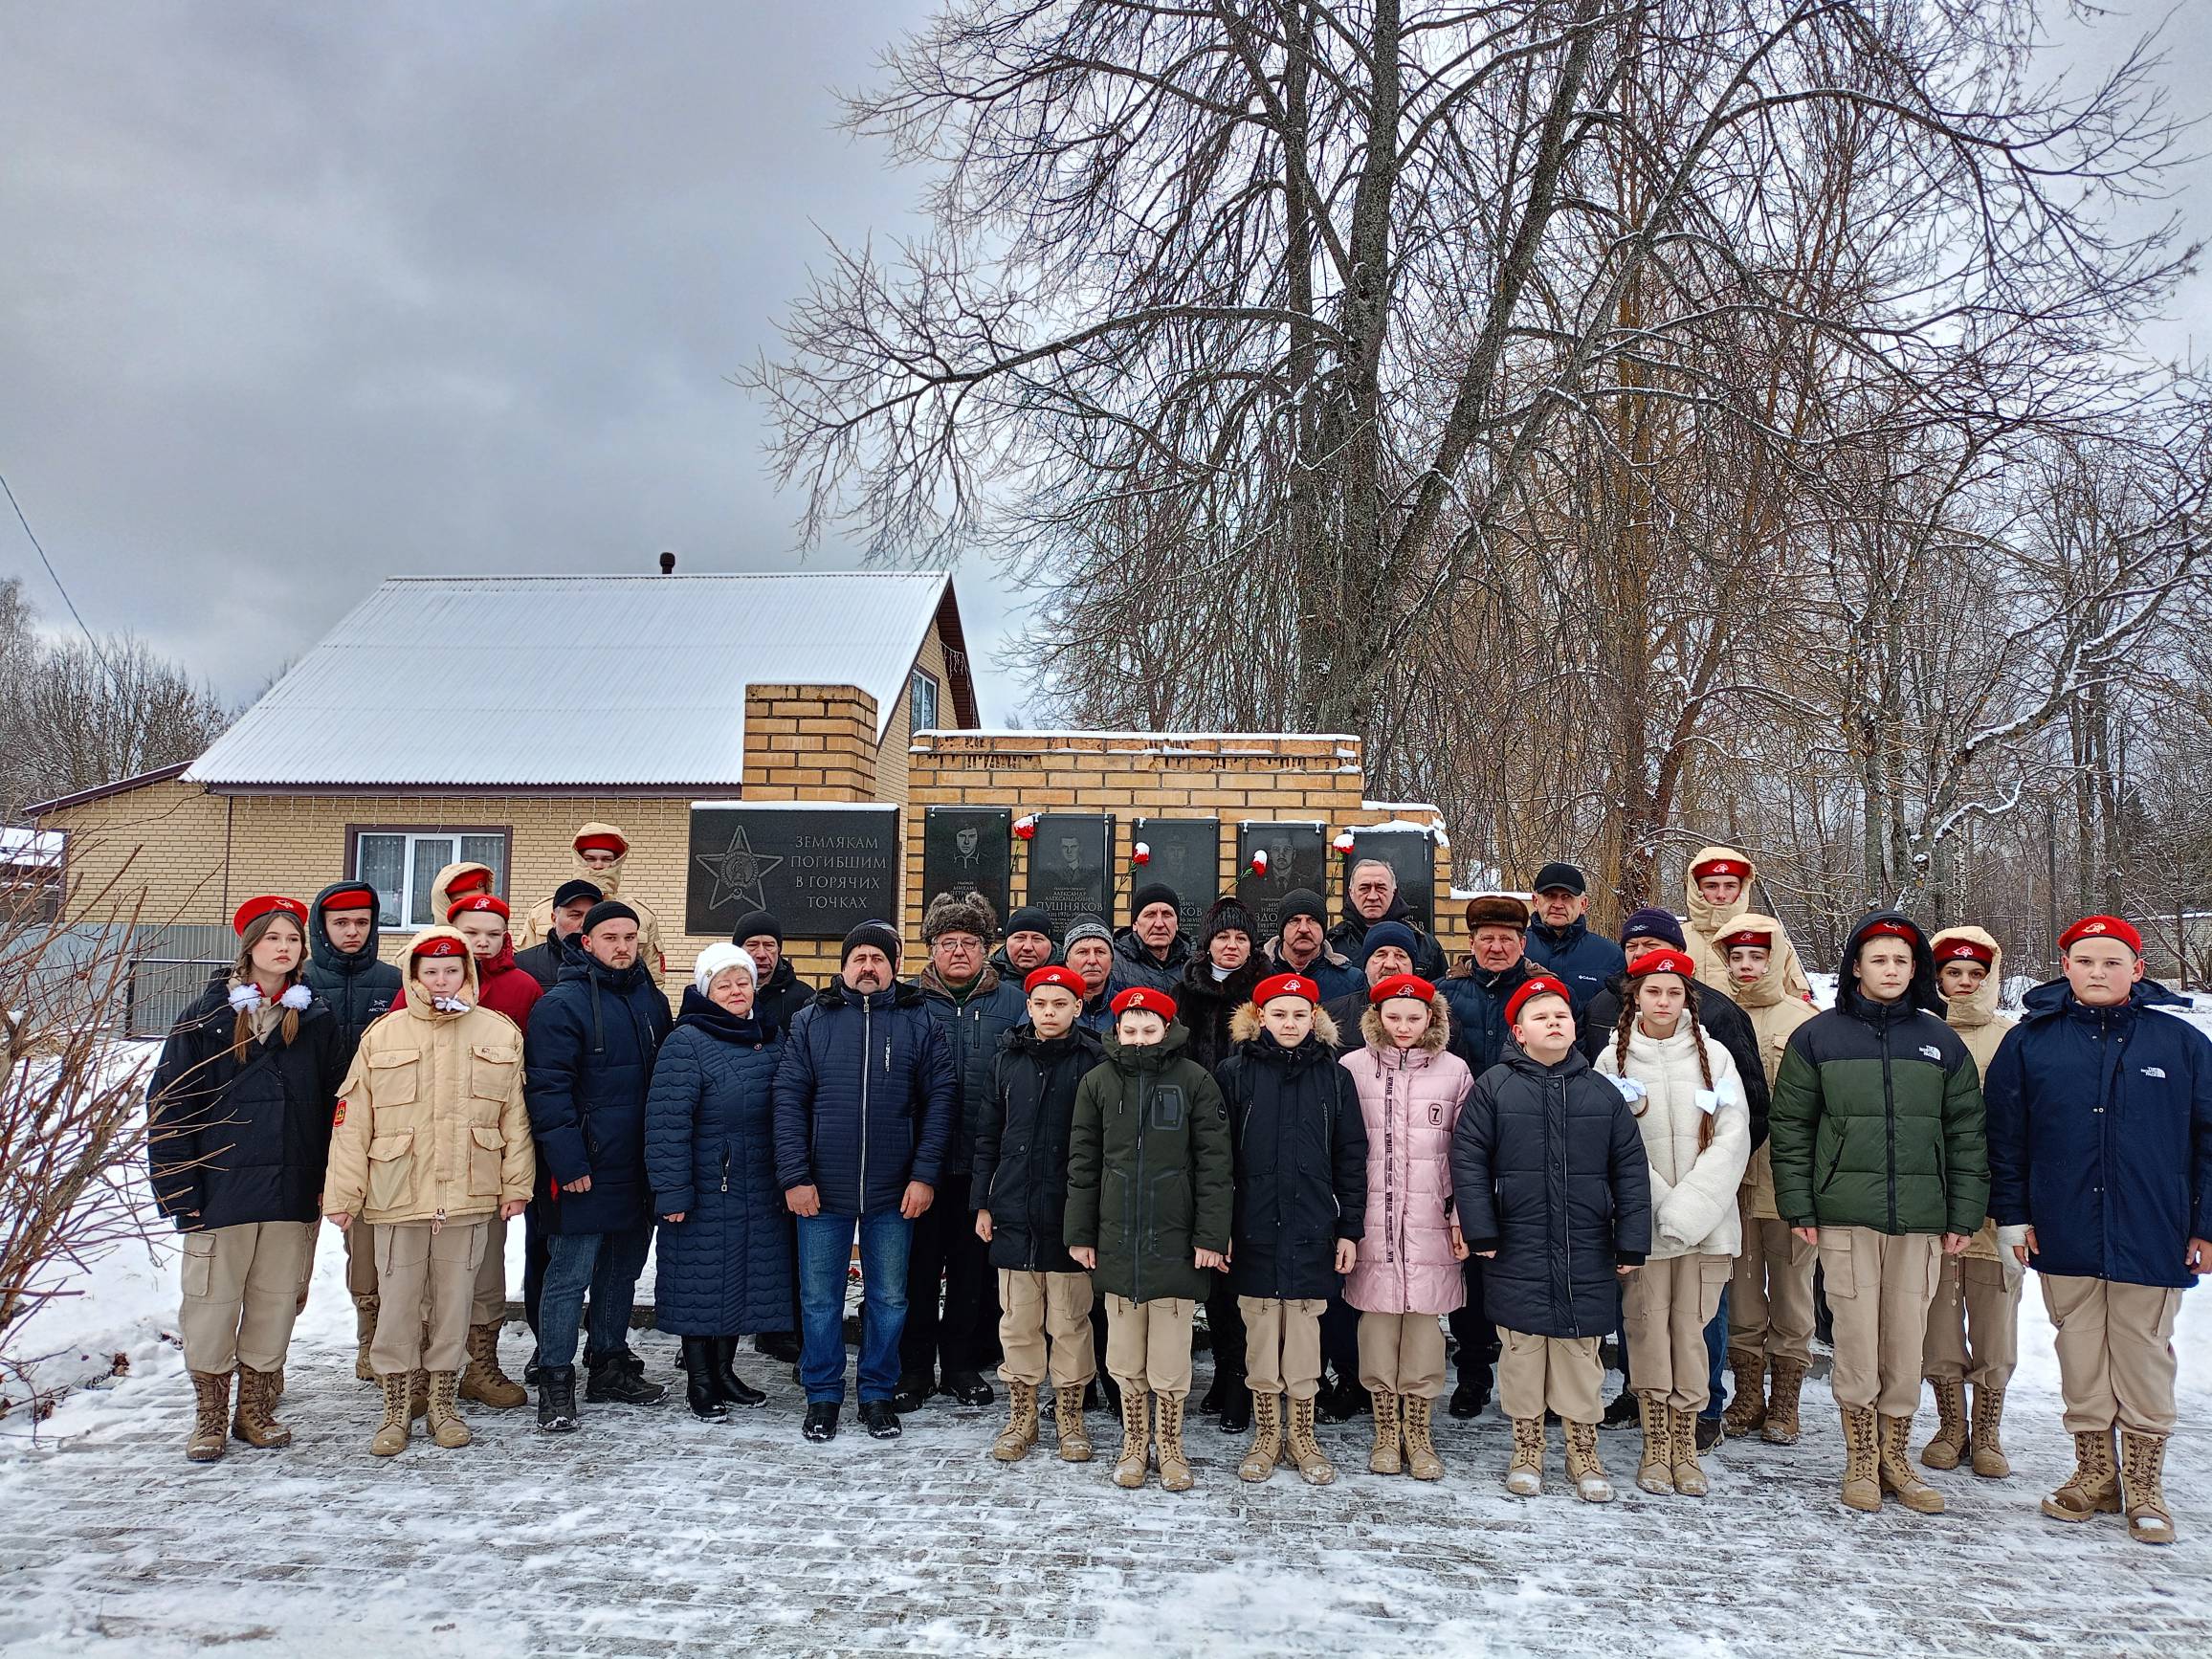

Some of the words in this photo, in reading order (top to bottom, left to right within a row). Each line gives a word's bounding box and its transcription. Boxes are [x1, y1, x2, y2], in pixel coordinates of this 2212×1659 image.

[795, 835, 878, 849] ЗЕМЛЯКАМ
[790, 855, 887, 869] ПОГИБШИМ
[795, 875, 804, 888] В
[809, 875, 880, 889] ГОРЯЧИХ
[807, 896, 868, 909] ТОЧКАХ
[1036, 901, 1104, 912] ПУШНЯКОВ
[1431, 1108, 1440, 1120] 7
